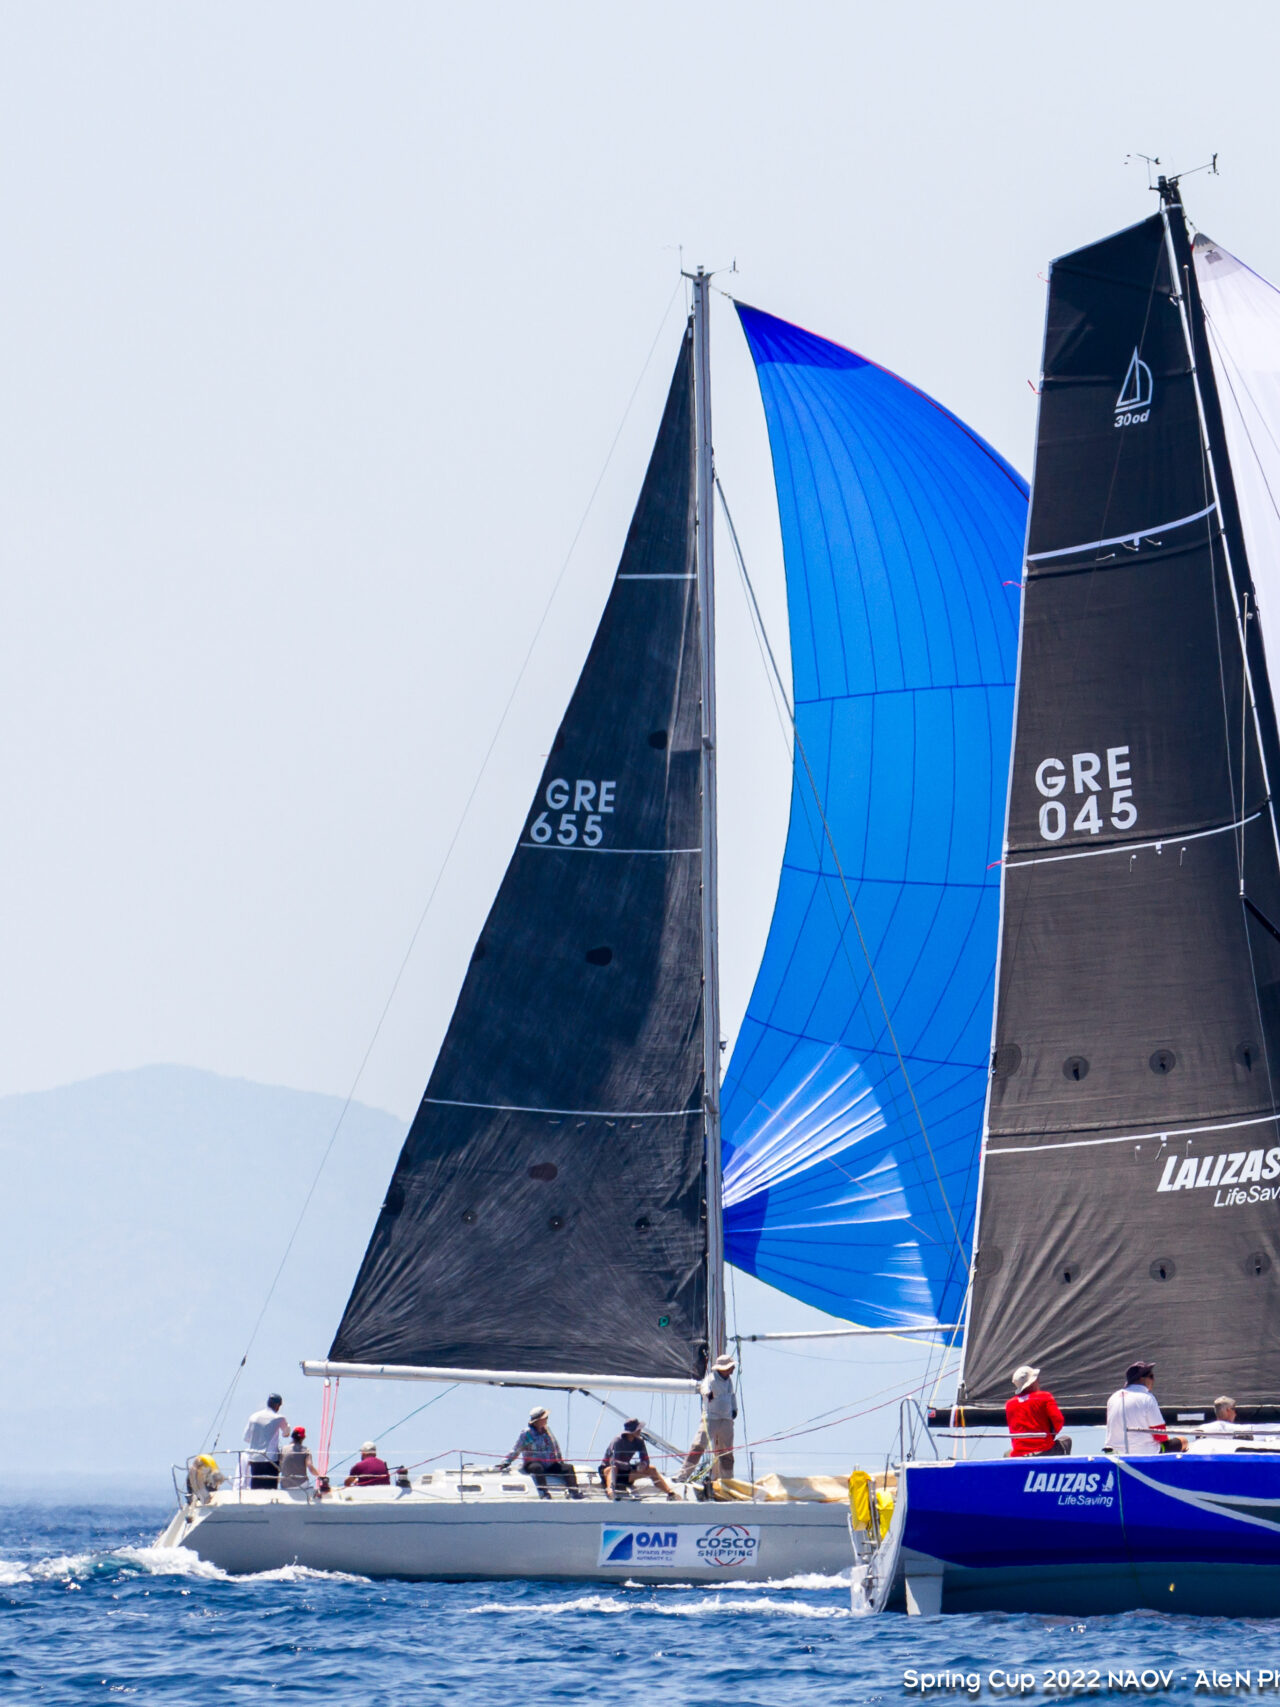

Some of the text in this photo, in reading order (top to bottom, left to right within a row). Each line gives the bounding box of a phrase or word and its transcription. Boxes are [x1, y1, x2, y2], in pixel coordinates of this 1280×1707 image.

[1114, 408, 1151, 428] 30od
[1035, 745, 1132, 798] GRE
[545, 778, 616, 813] GRE
[1038, 789, 1138, 841] 045
[530, 812, 603, 847] 655
[1023, 1470, 1101, 1492] LALIZAS
[696, 1537, 757, 1549] COSCO
[697, 1549, 753, 1557] SHIPPING
